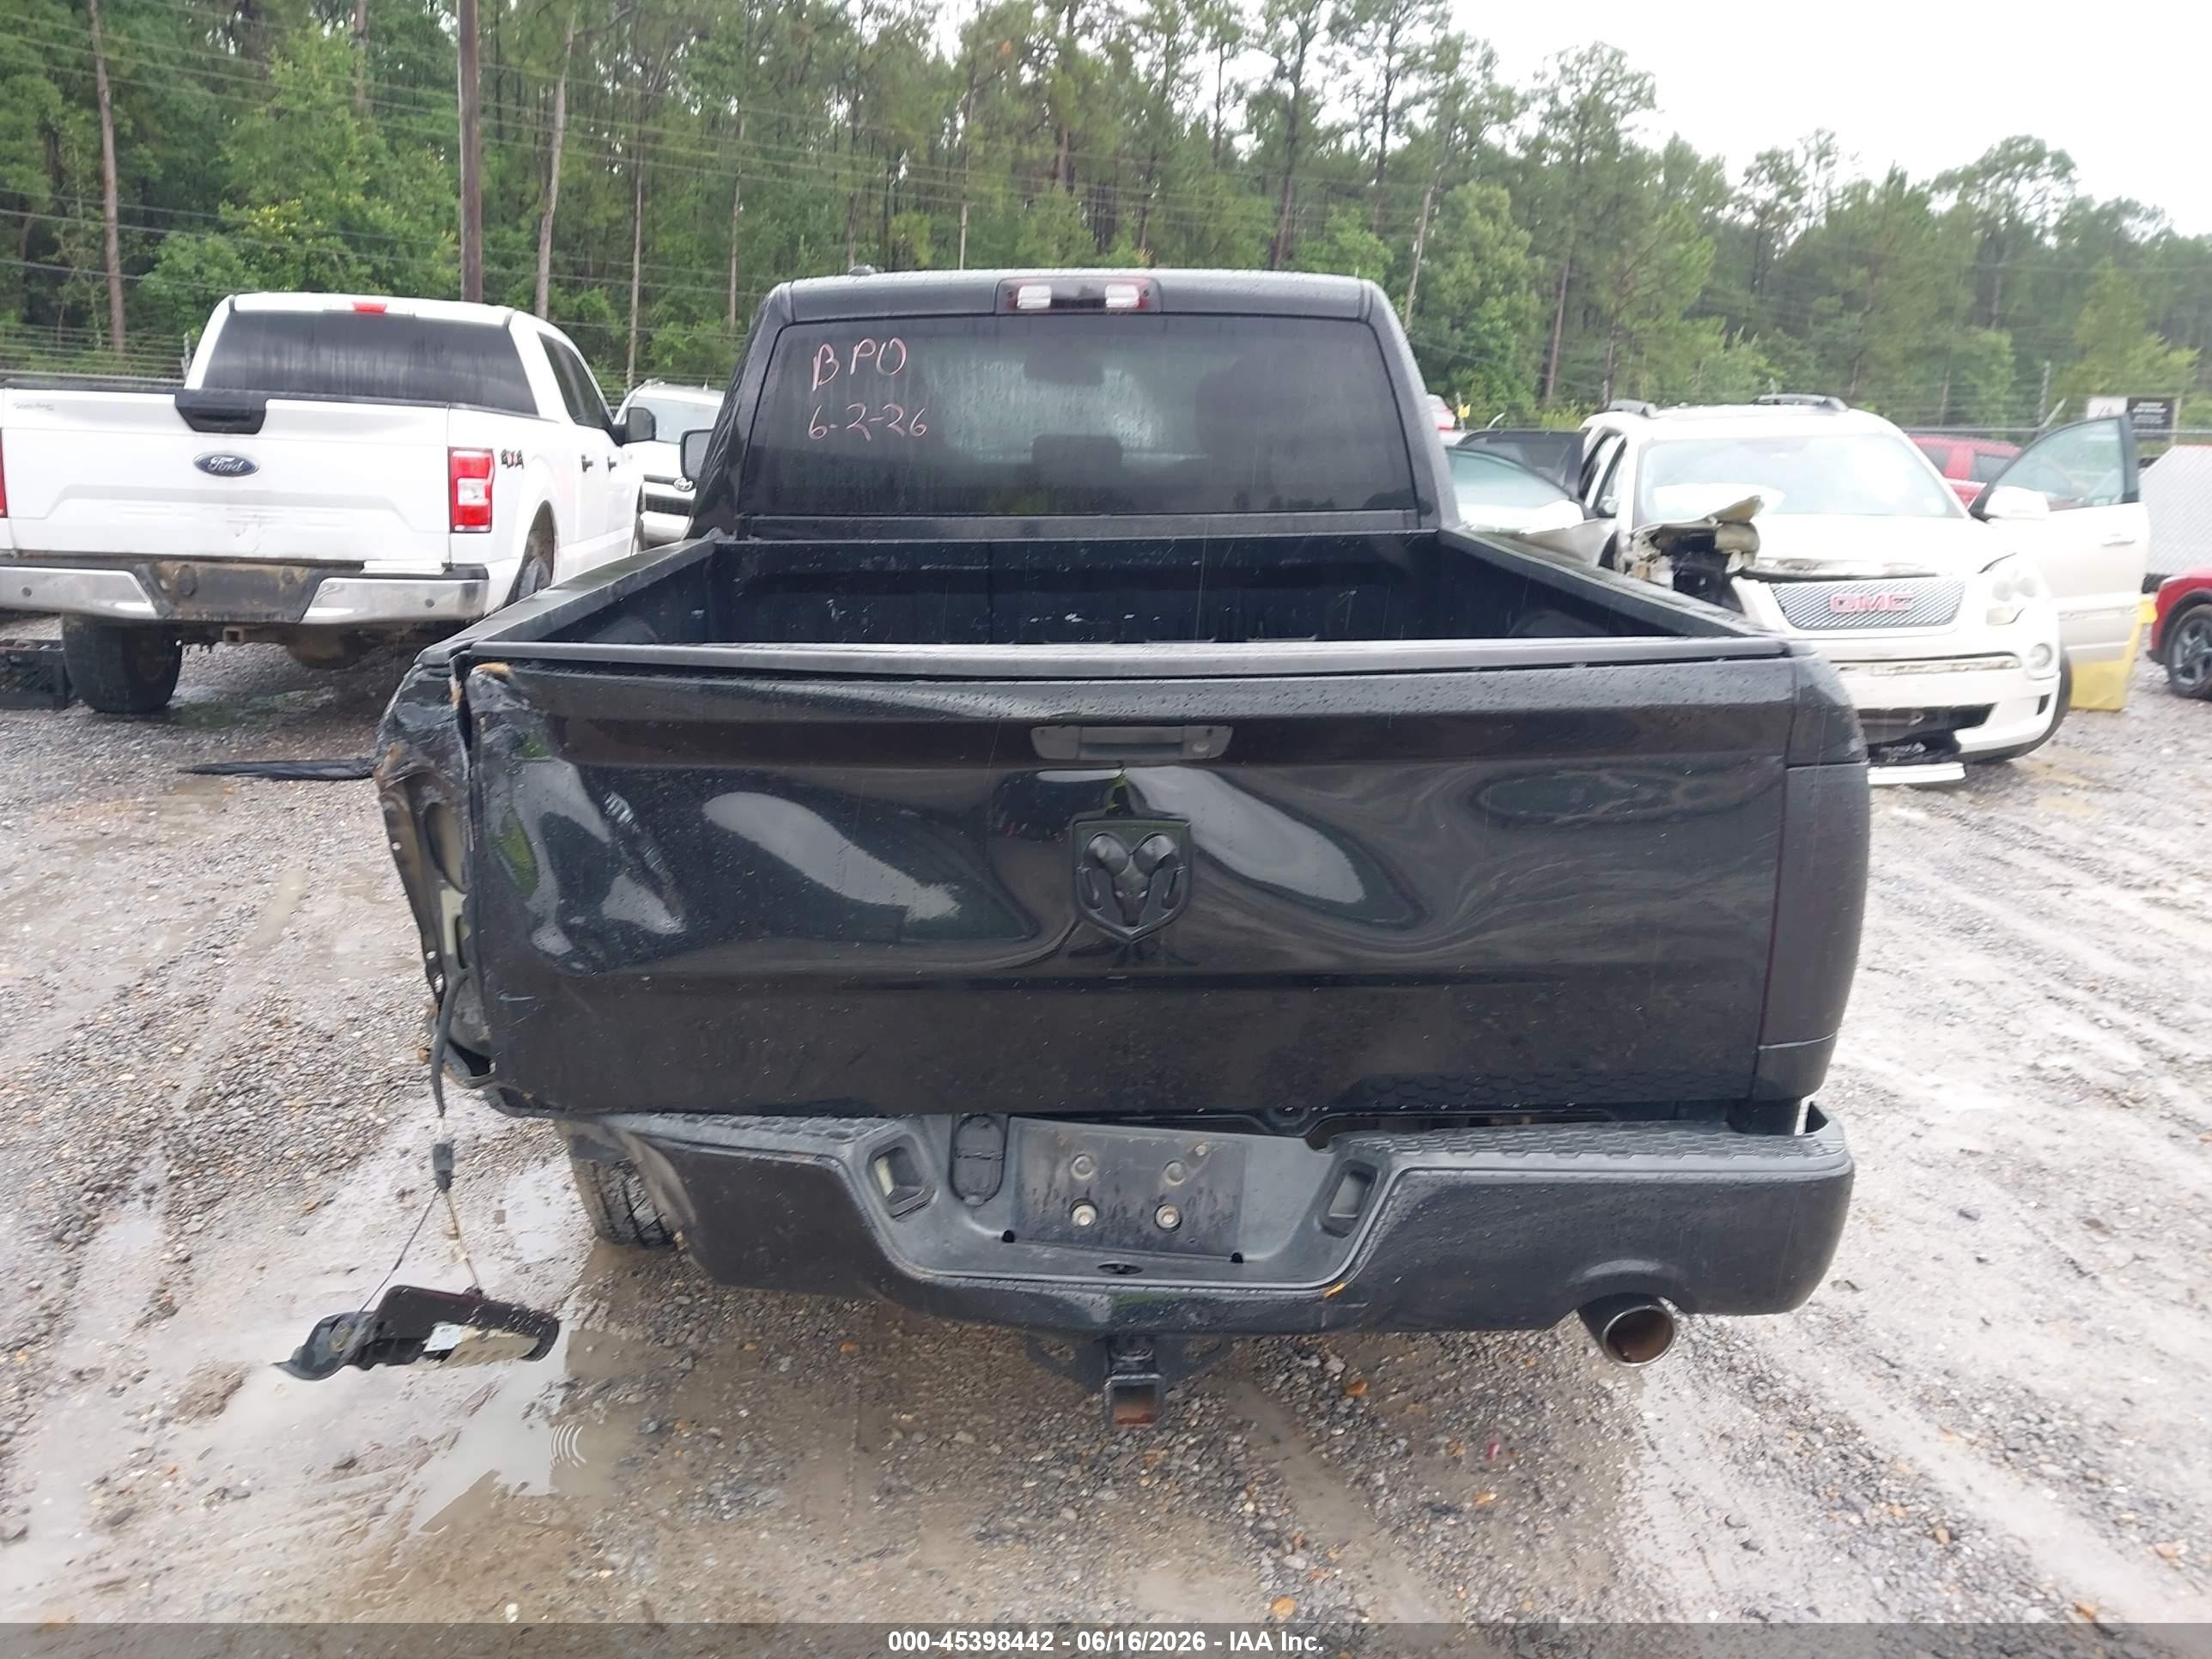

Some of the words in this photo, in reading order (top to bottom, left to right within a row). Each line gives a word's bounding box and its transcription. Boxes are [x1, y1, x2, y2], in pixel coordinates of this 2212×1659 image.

[808, 403, 927, 442] 6-2-26
[208, 456, 245, 472] Ford
[1829, 592, 1912, 613] GMC
